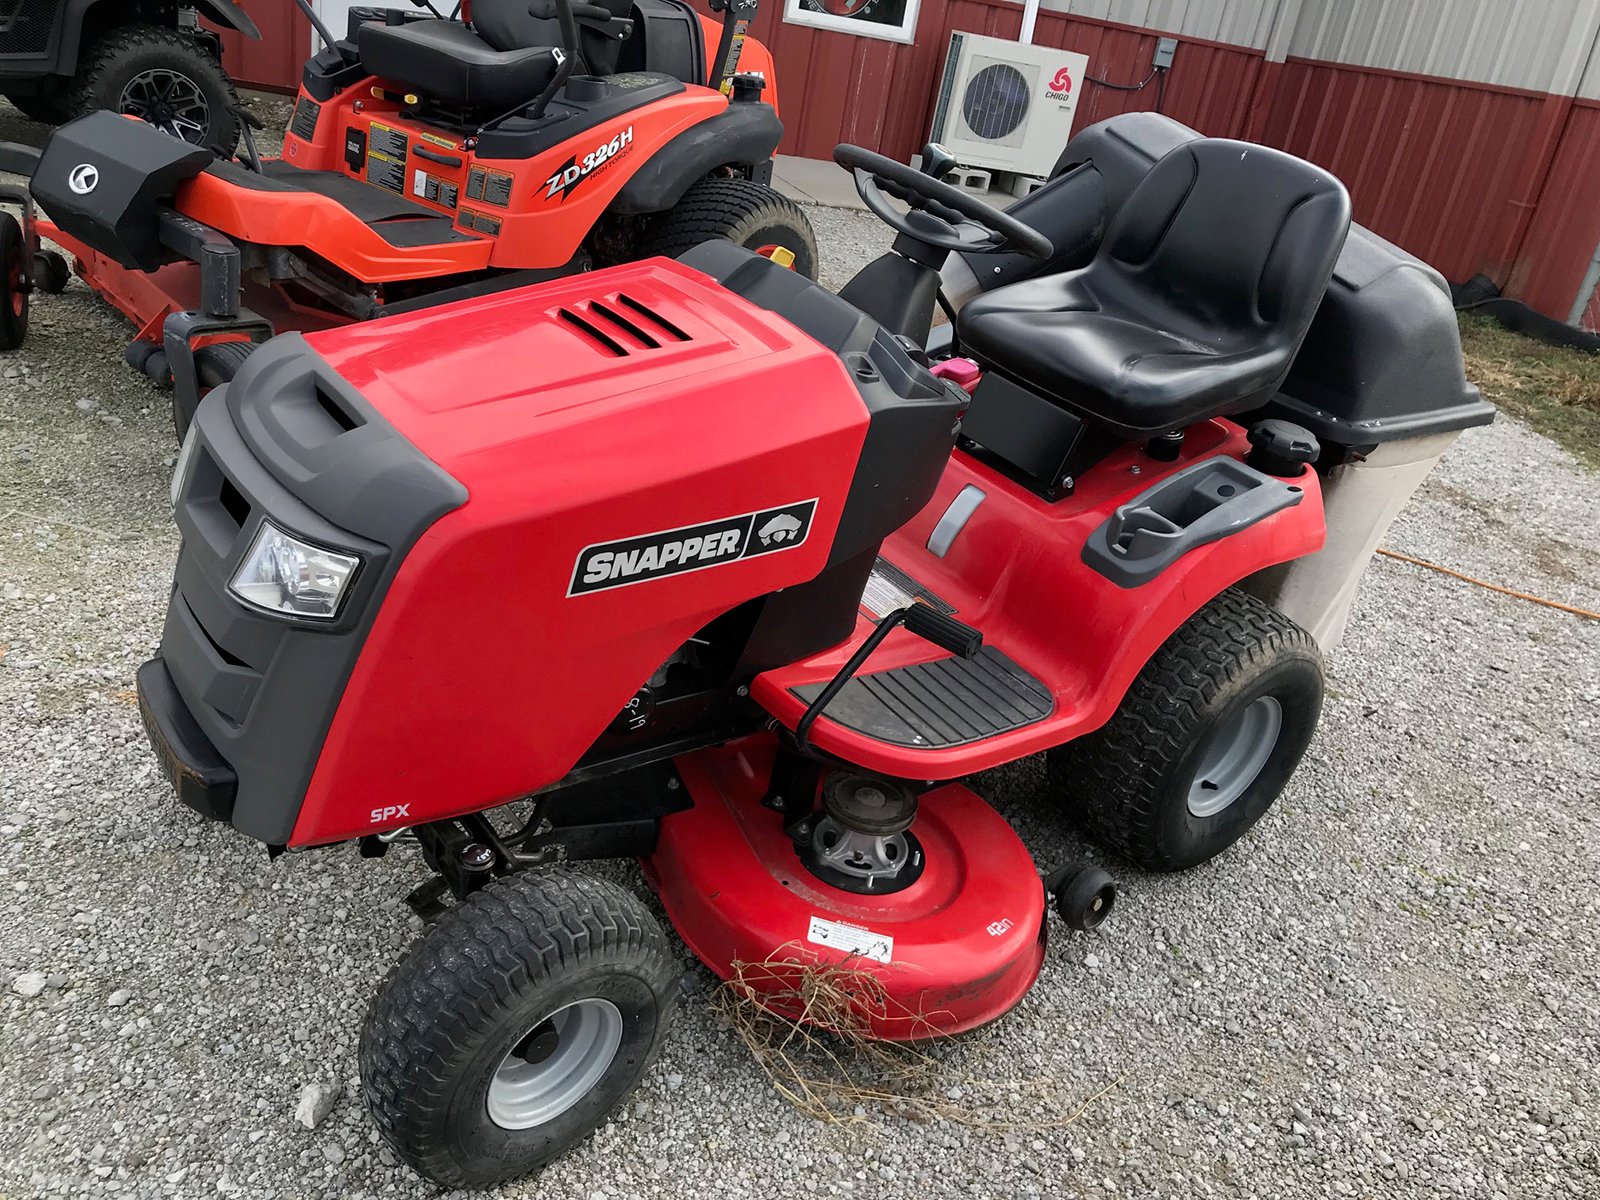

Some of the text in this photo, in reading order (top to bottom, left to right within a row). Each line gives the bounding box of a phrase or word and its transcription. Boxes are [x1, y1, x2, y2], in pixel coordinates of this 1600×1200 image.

[1045, 91, 1069, 102] CHIGO
[590, 164, 608, 180] HIGH
[583, 528, 741, 584] SNAPPER
[370, 803, 411, 823] SPX
[842, 920, 869, 931] DANGER
